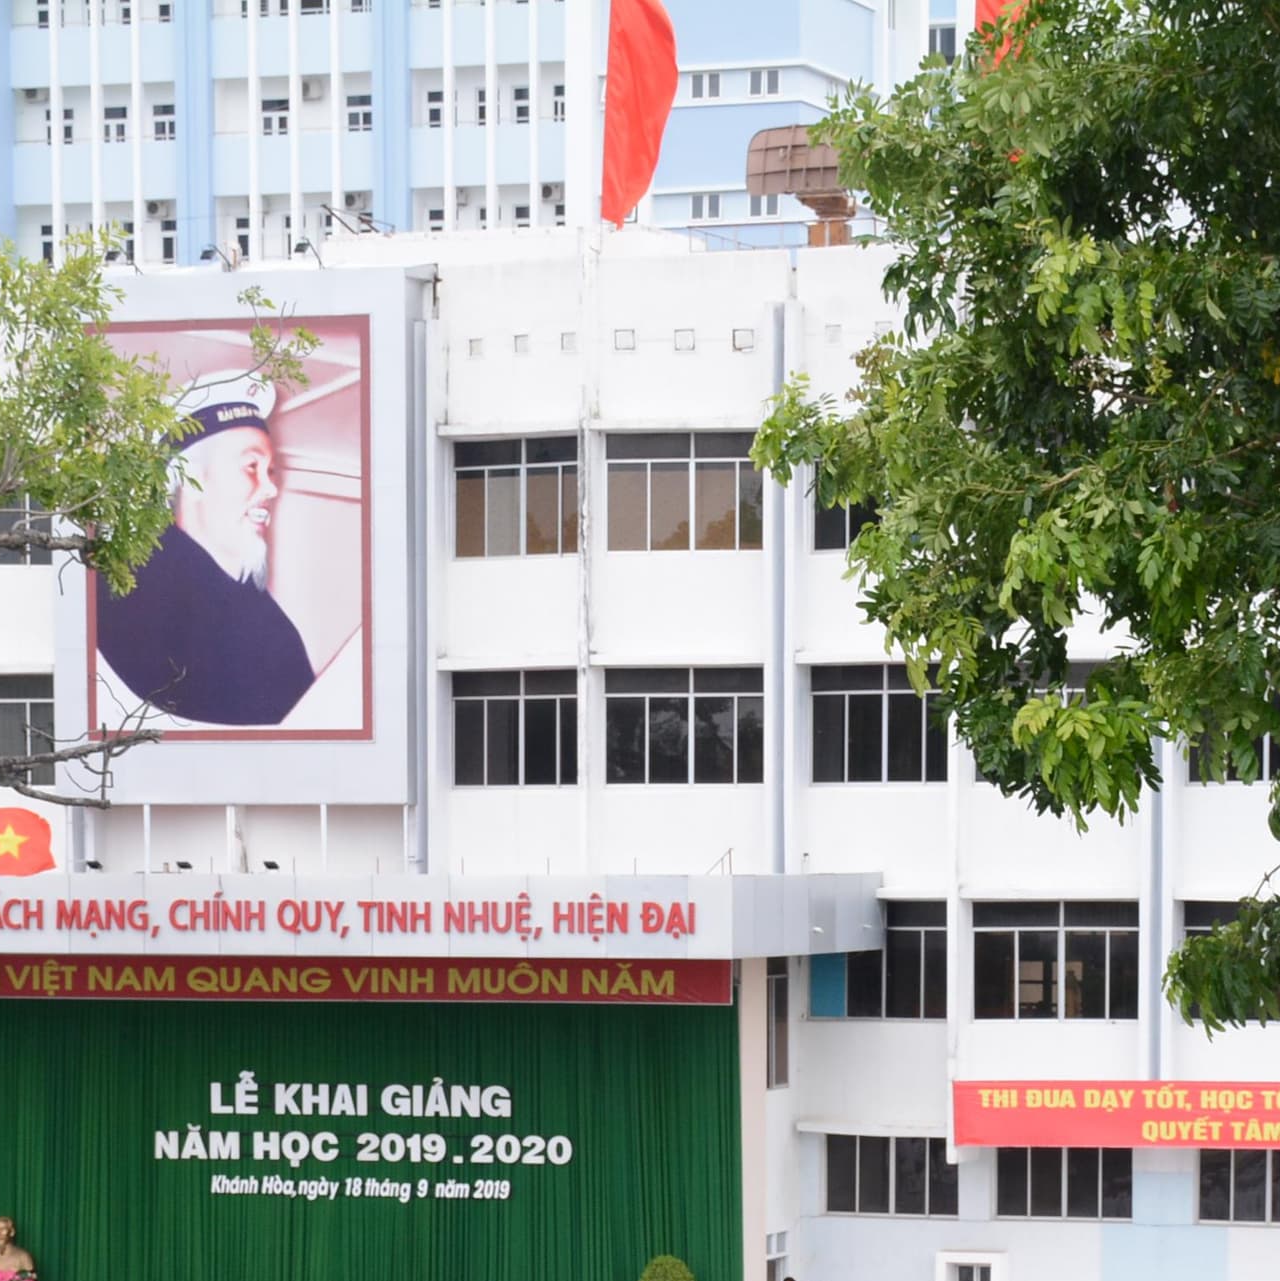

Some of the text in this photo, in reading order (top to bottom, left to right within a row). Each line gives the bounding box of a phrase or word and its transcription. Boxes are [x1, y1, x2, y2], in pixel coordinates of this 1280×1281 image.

[56, 899, 160, 939] MẠNG,
[169, 891, 265, 932] CHÍNH
[277, 899, 350, 939] QUY,
[357, 901, 432, 933] TINH
[443, 892, 543, 942] NHUỆ,
[553, 892, 629, 942] HIỆN
[640, 901, 696, 940] ĐẠI
[5, 960, 77, 996] VIỆT
[88, 966, 175, 991] NAM
[186, 966, 332, 994] QUANG
[342, 967, 434, 994] VINH
[448, 962, 568, 994] MUÔN
[582, 963, 675, 995] NĂM
[210, 1070, 512, 1118] LỄ KHAI GIẢNG
[978, 1089, 1018, 1109] THI
[1025, 1089, 1077, 1109] ĐUA
[1084, 1089, 1134, 1112] DẠY
[1142, 1083, 1192, 1111] TỐT,
[1200, 1090, 1254, 1113] HỌC
[154, 1123, 240, 1160] NĂM
[253, 1131, 339, 1168] HỌC
[1142, 1116, 1223, 1143] QUYẾT
[211, 1175, 259, 1195] Khánh
[298, 1176, 339, 1201] ngày
[345, 1177, 362, 1197] 18
[365, 1177, 411, 1203] tháng
[417, 1178, 428, 1198] 9
[435, 1179, 470, 1198] năm
[473, 1179, 511, 1199] 2019
